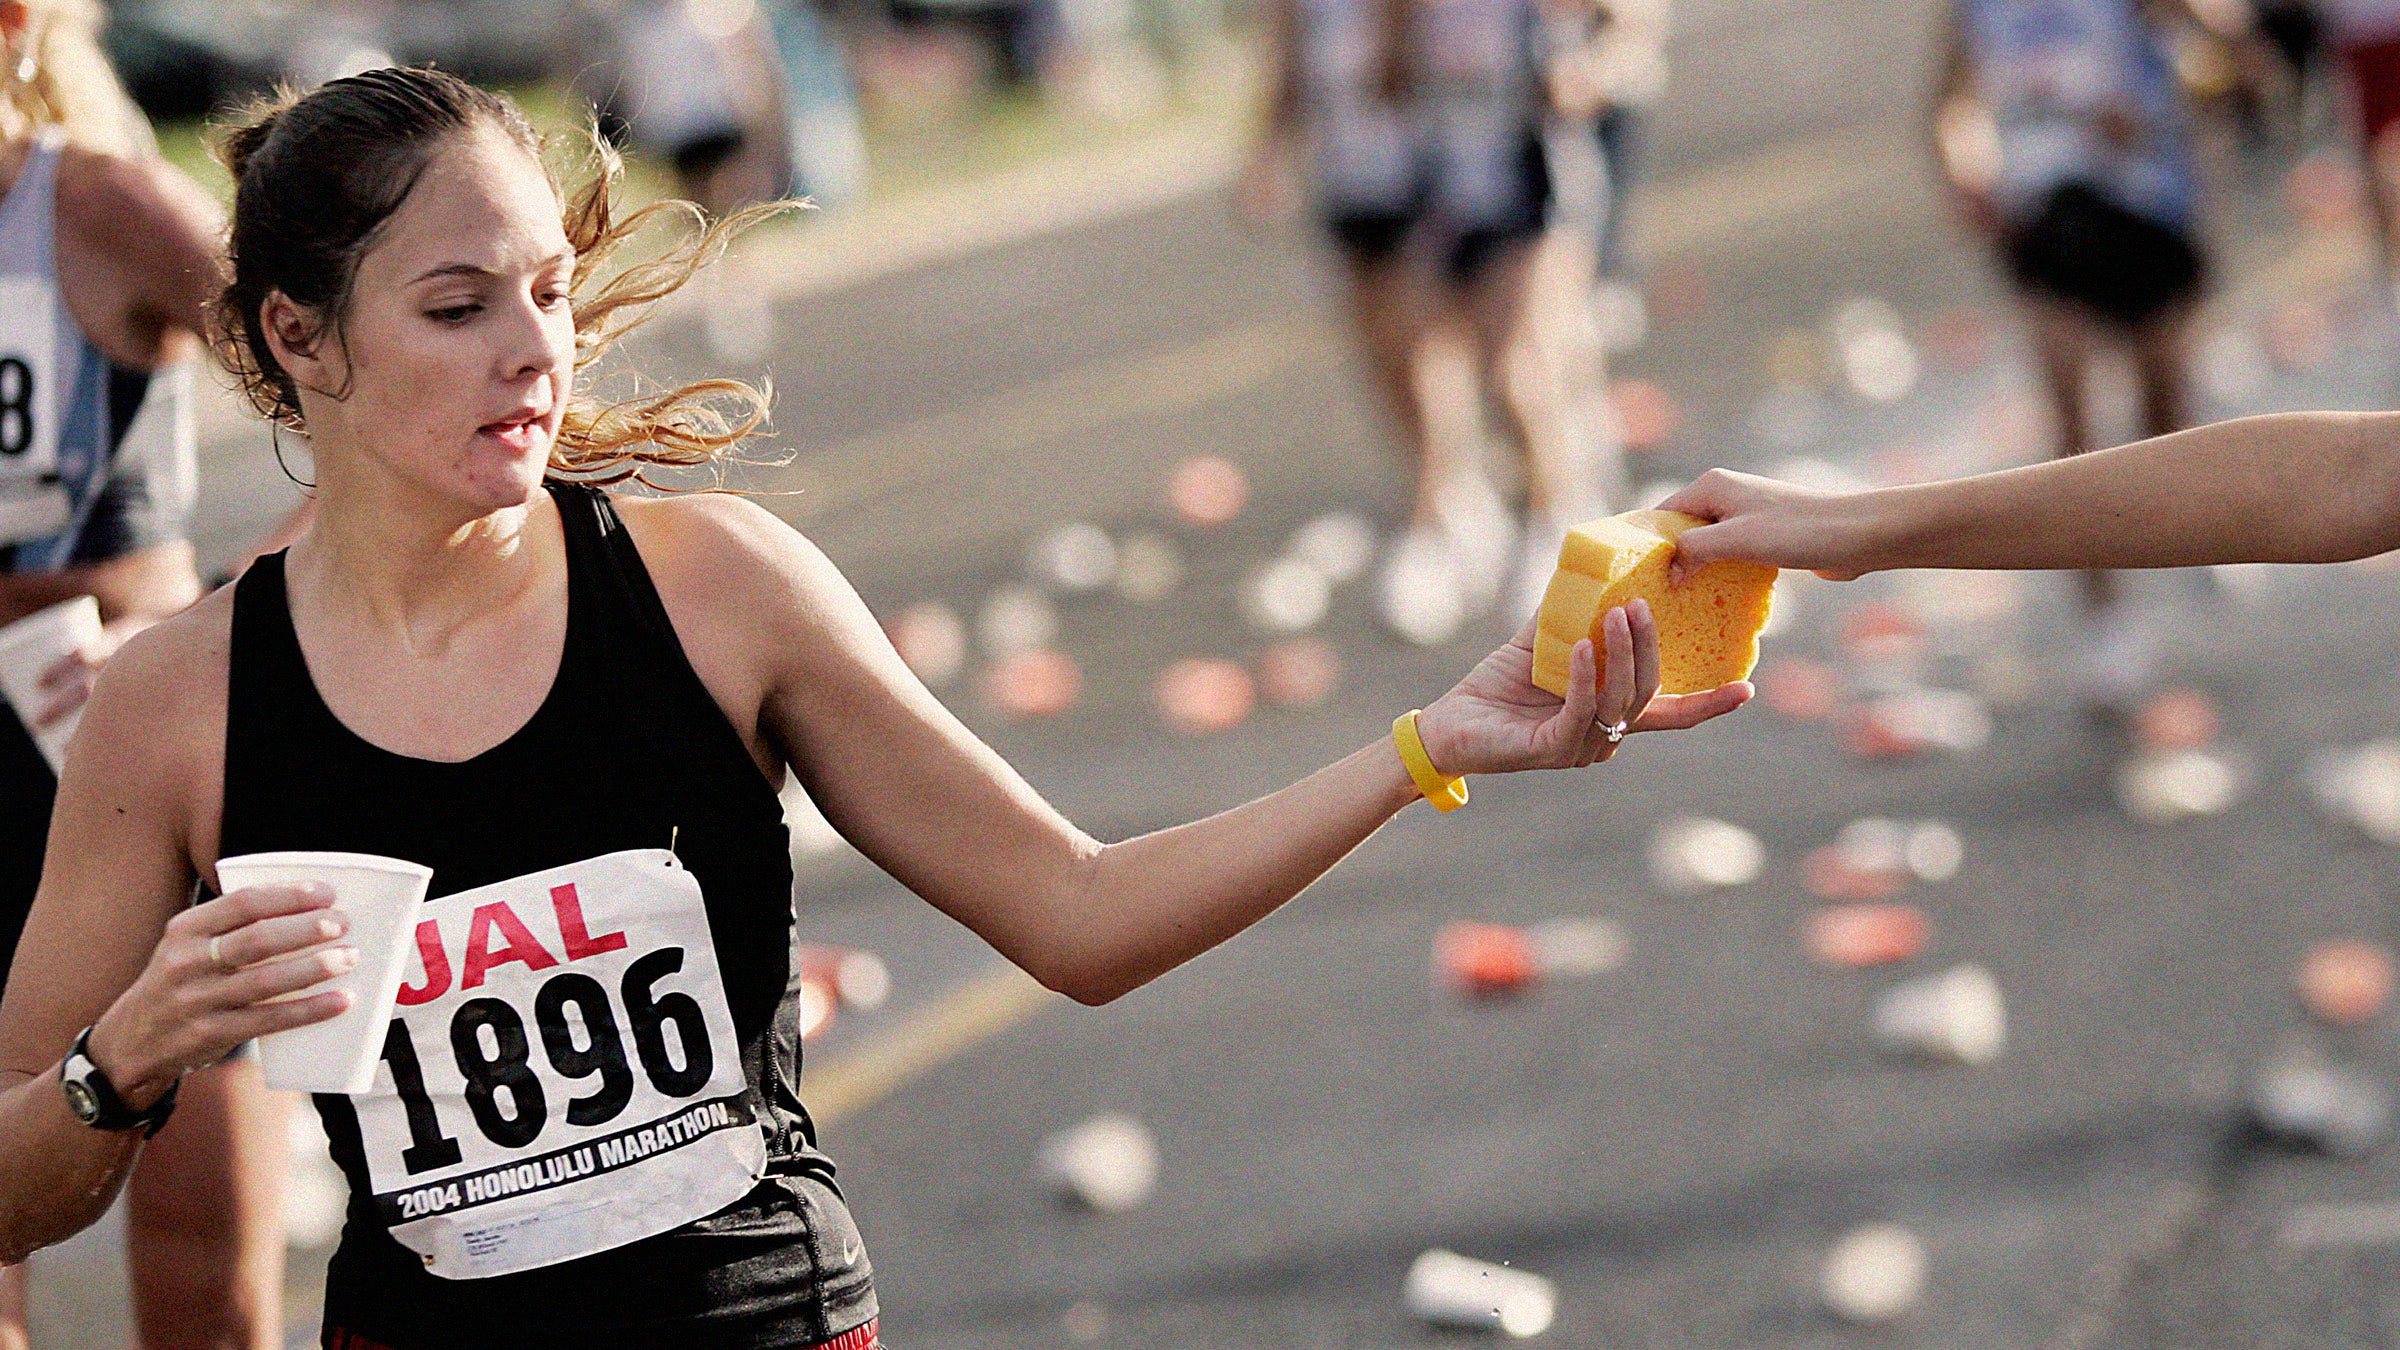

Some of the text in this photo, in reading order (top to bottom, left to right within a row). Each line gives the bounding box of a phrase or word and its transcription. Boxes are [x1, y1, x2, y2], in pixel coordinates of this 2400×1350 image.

[394, 882, 629, 1006] JAL
[379, 946, 714, 1176] 1896
[397, 1102, 729, 1218] 2004 HONOLULU MARATHON
